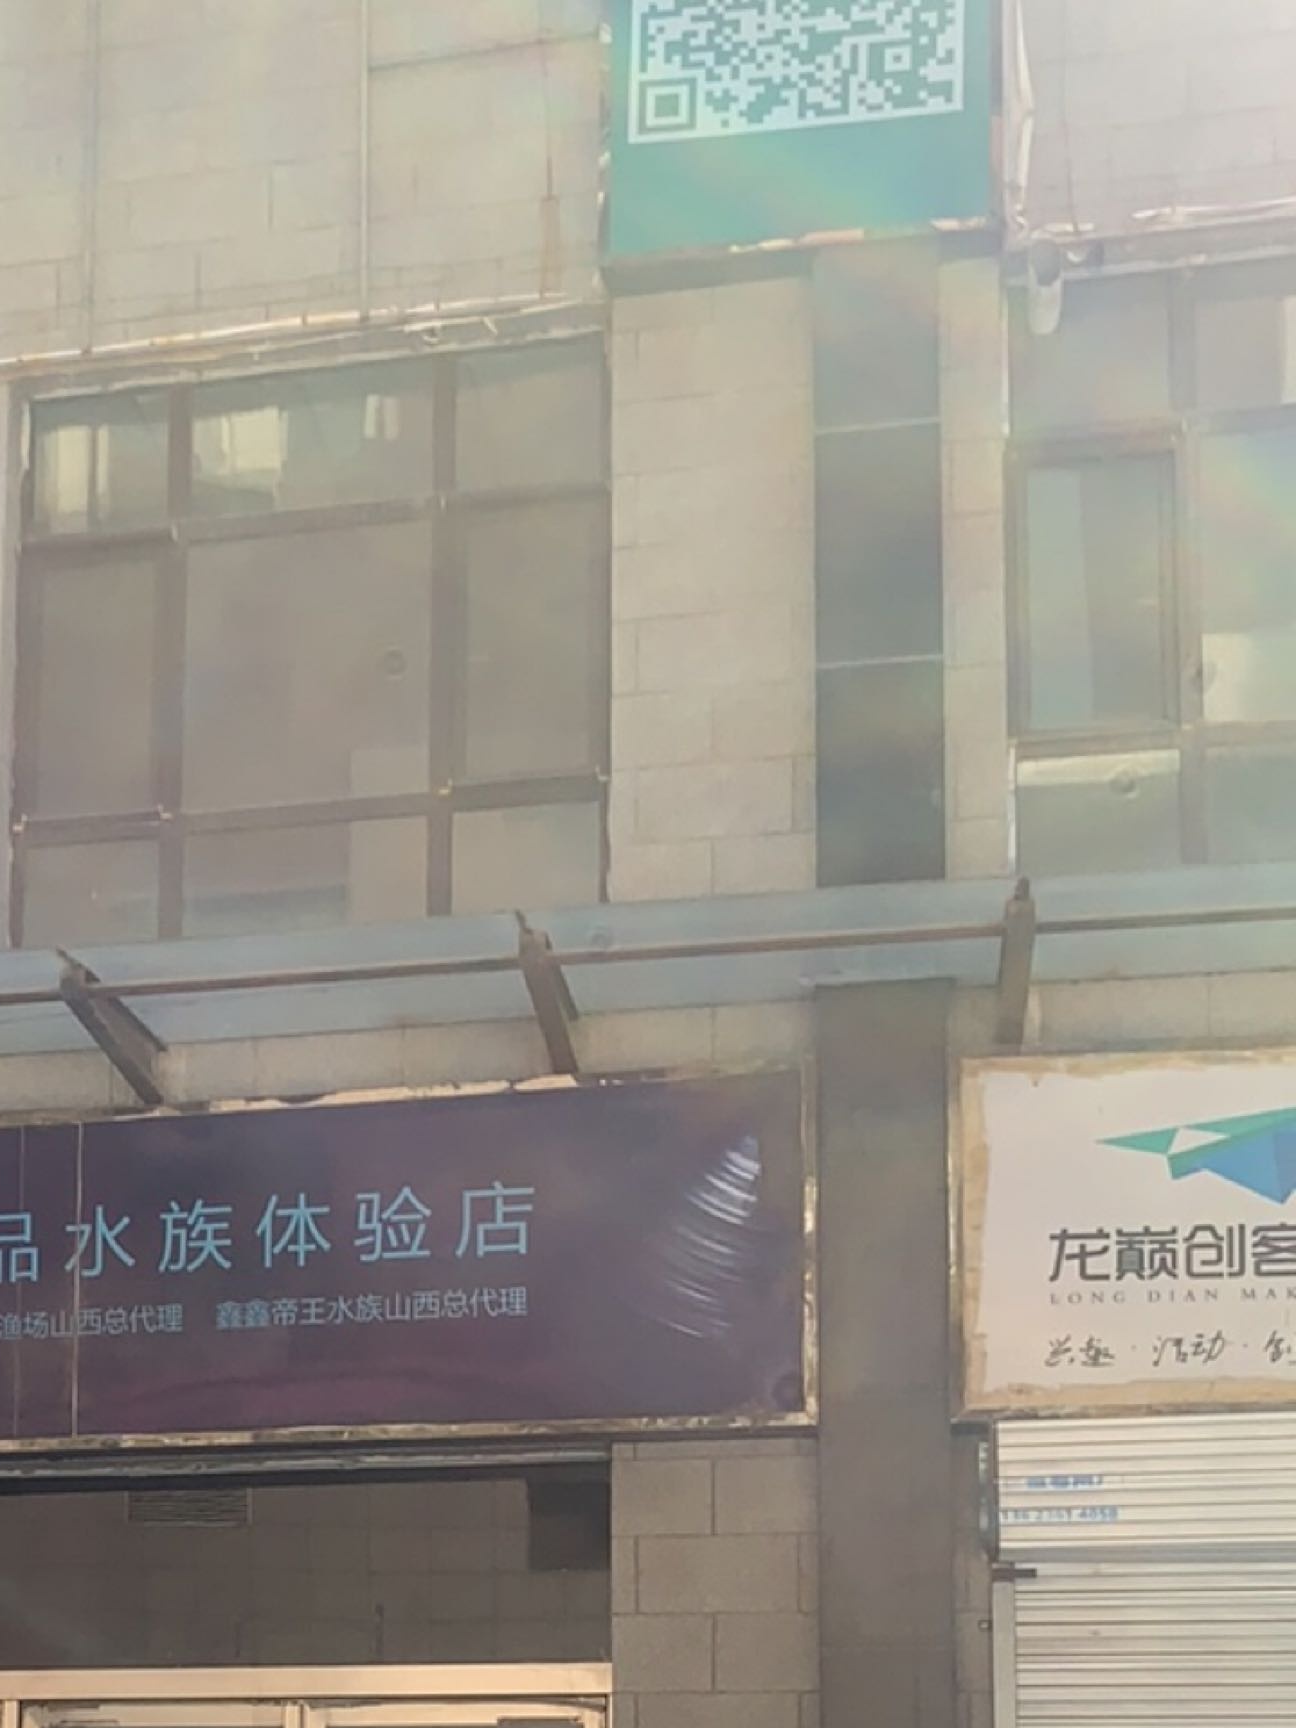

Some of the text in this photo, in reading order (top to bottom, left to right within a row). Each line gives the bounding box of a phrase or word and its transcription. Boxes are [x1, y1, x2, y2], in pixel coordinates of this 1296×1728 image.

[1049, 1222, 1296, 1282] 龙巅创客
[1050, 1290, 1125, 1305] LONG
[1148, 1287, 1219, 1302] DIAN
